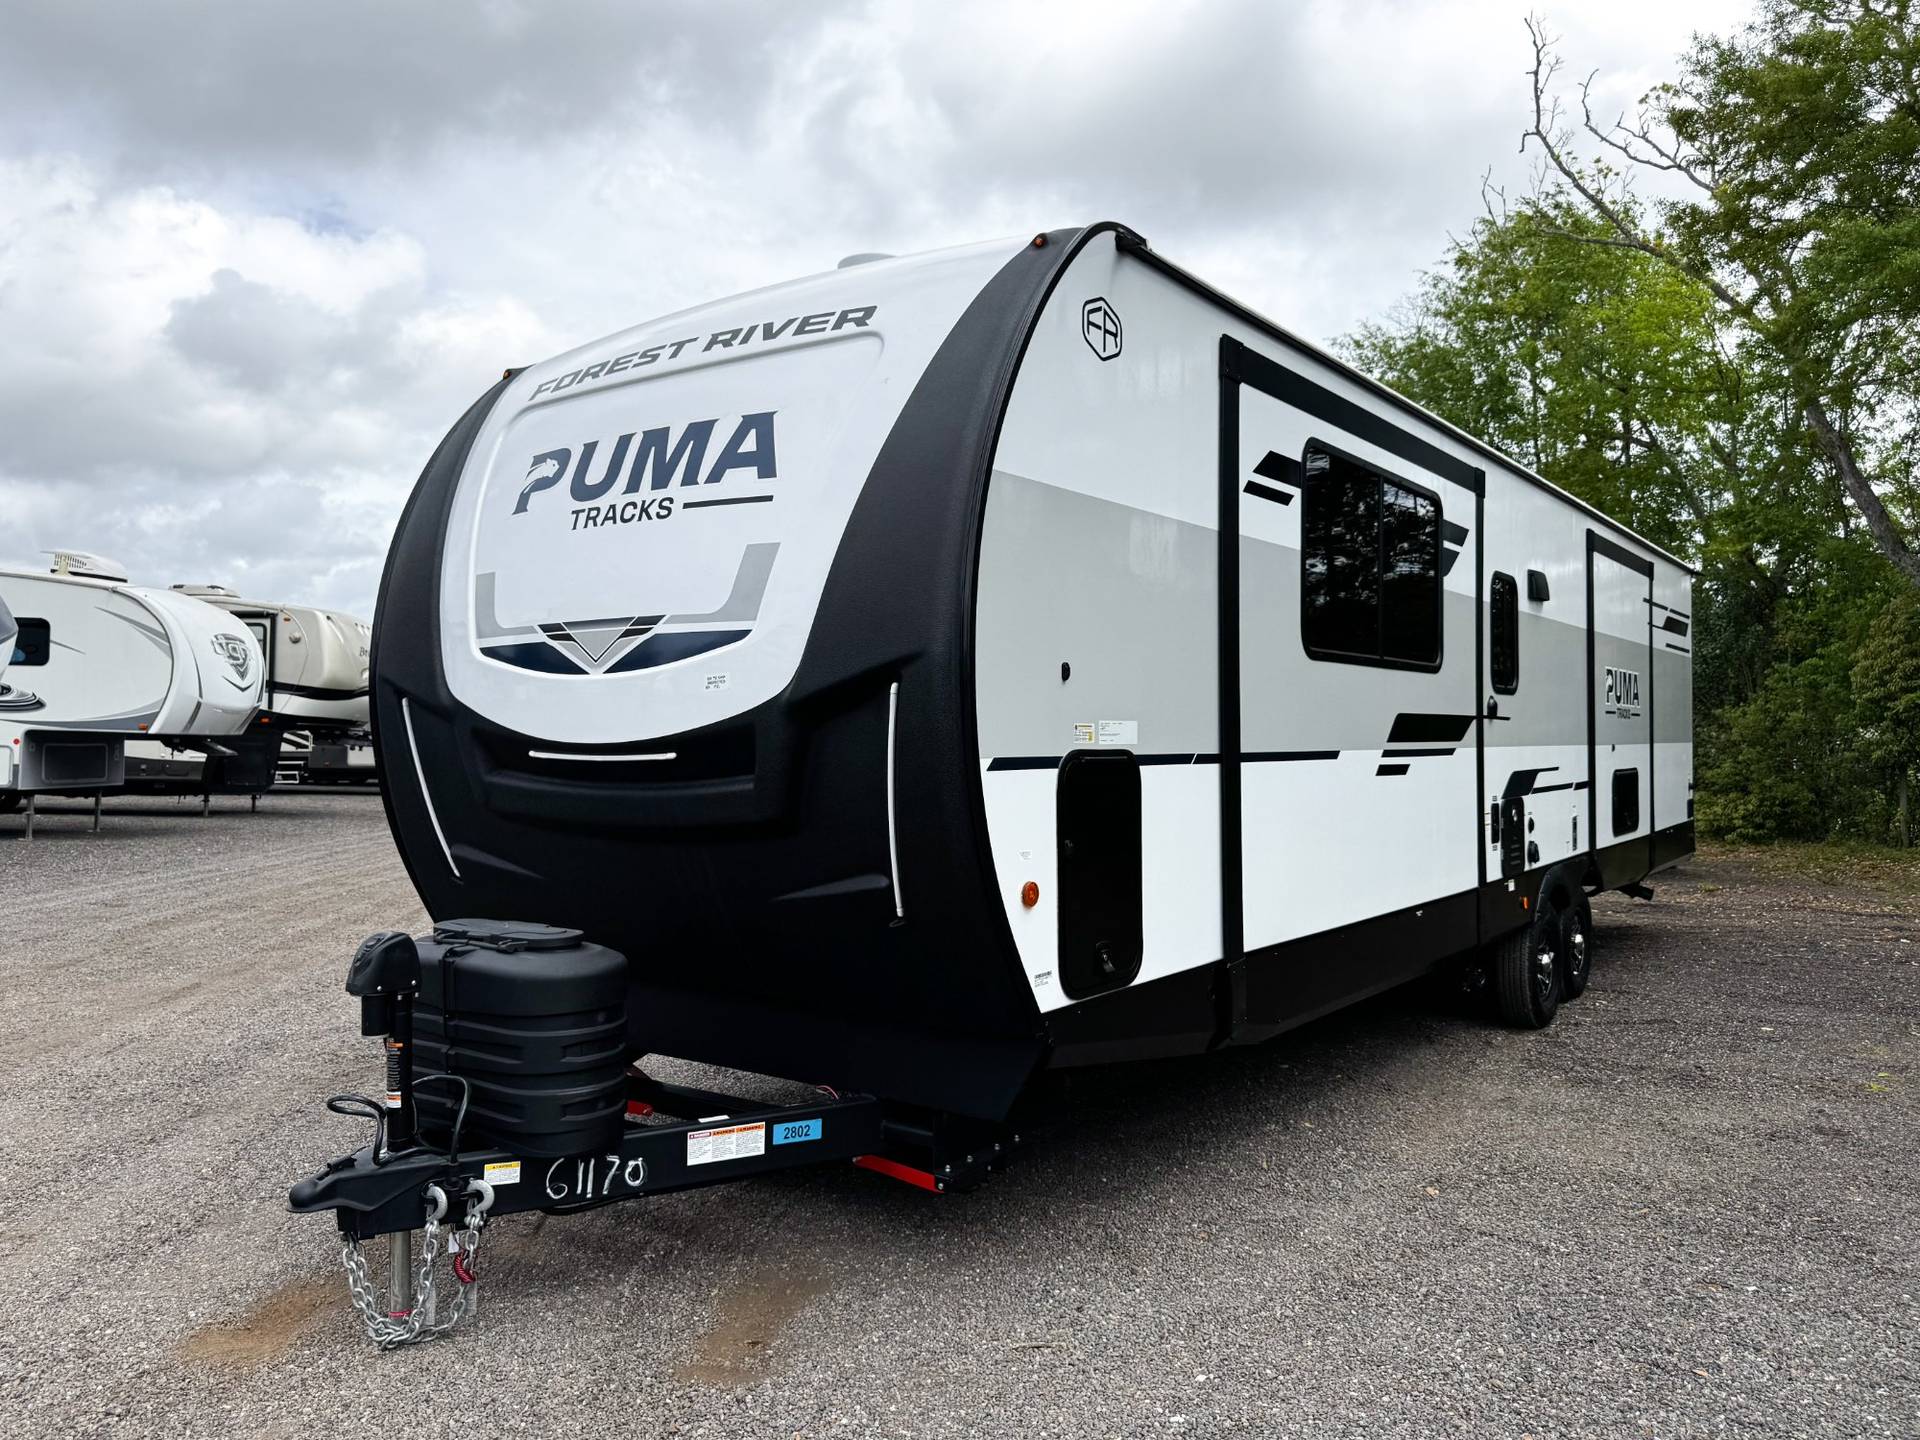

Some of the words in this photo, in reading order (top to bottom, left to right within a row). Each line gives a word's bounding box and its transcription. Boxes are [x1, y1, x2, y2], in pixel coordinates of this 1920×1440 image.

[528, 336, 700, 401] FOREST
[702, 305, 878, 352] RIVER
[512, 410, 779, 515] PUMA
[571, 497, 674, 530] TRACKS
[1605, 667, 1640, 707] PUMA
[783, 1124, 811, 1140] 2802
[546, 1153, 646, 1199] 61170
